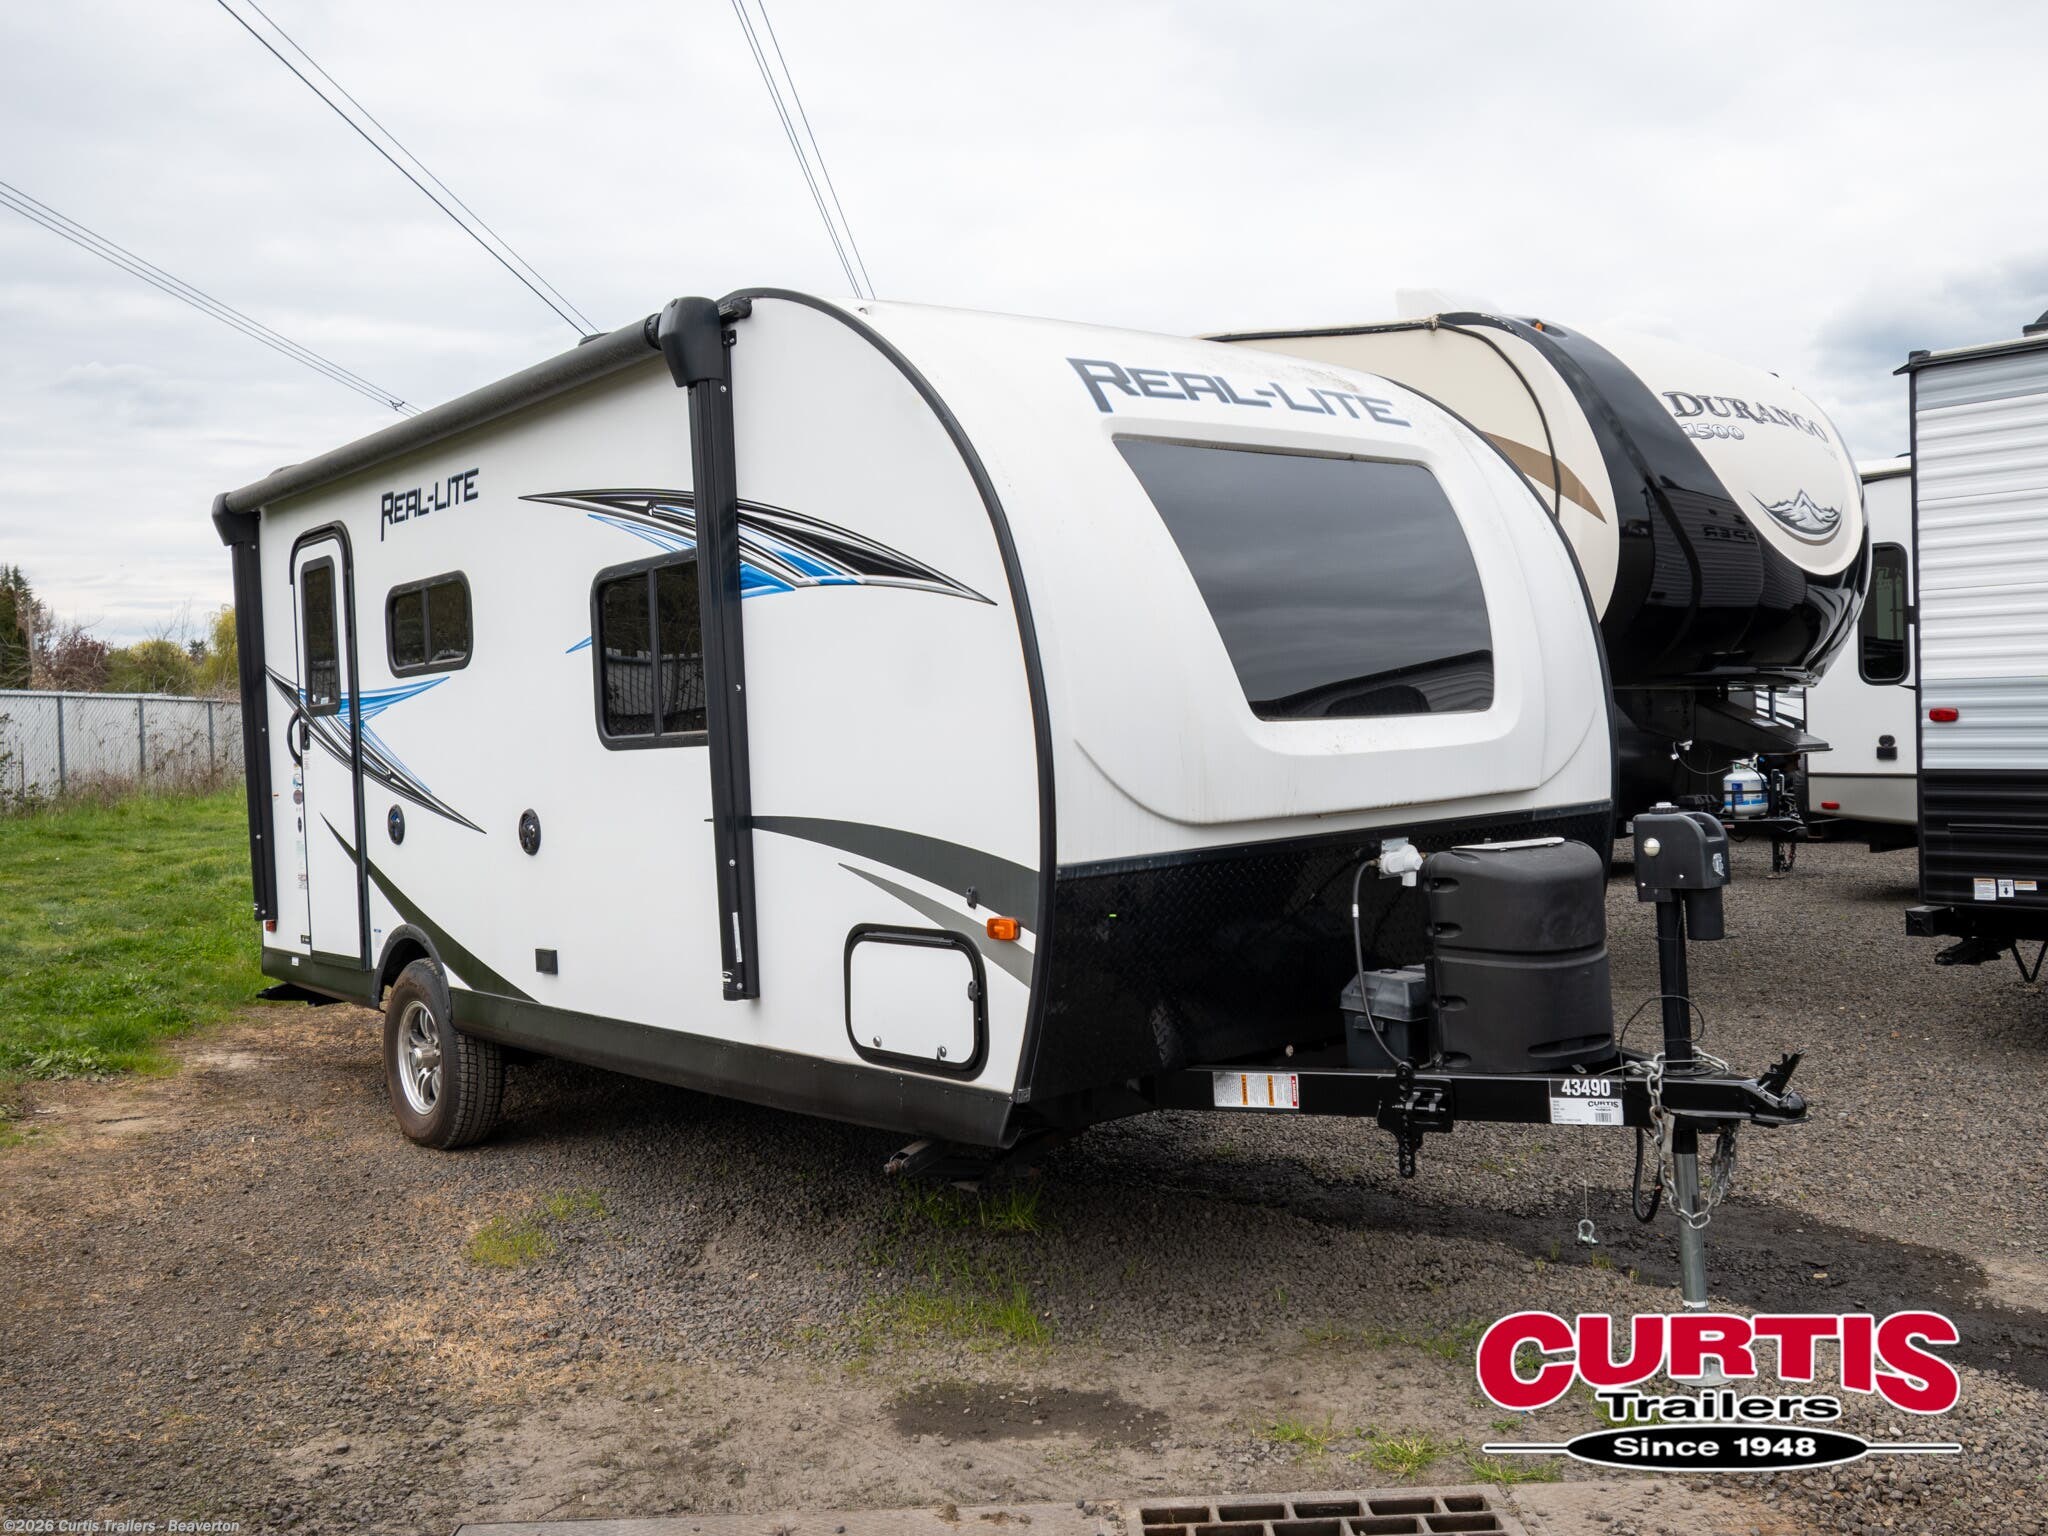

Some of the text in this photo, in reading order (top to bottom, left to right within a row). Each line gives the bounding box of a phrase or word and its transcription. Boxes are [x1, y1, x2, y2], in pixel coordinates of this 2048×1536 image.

[1065, 357, 1412, 428] REAL-LITE
[1661, 391, 1829, 443] DURANGO
[1681, 423, 1745, 440] 1500
[380, 467, 480, 543] REAL-LITE
[1561, 1079, 1611, 1097] 43490
[1587, 1100, 1619, 1109] CURTIS
